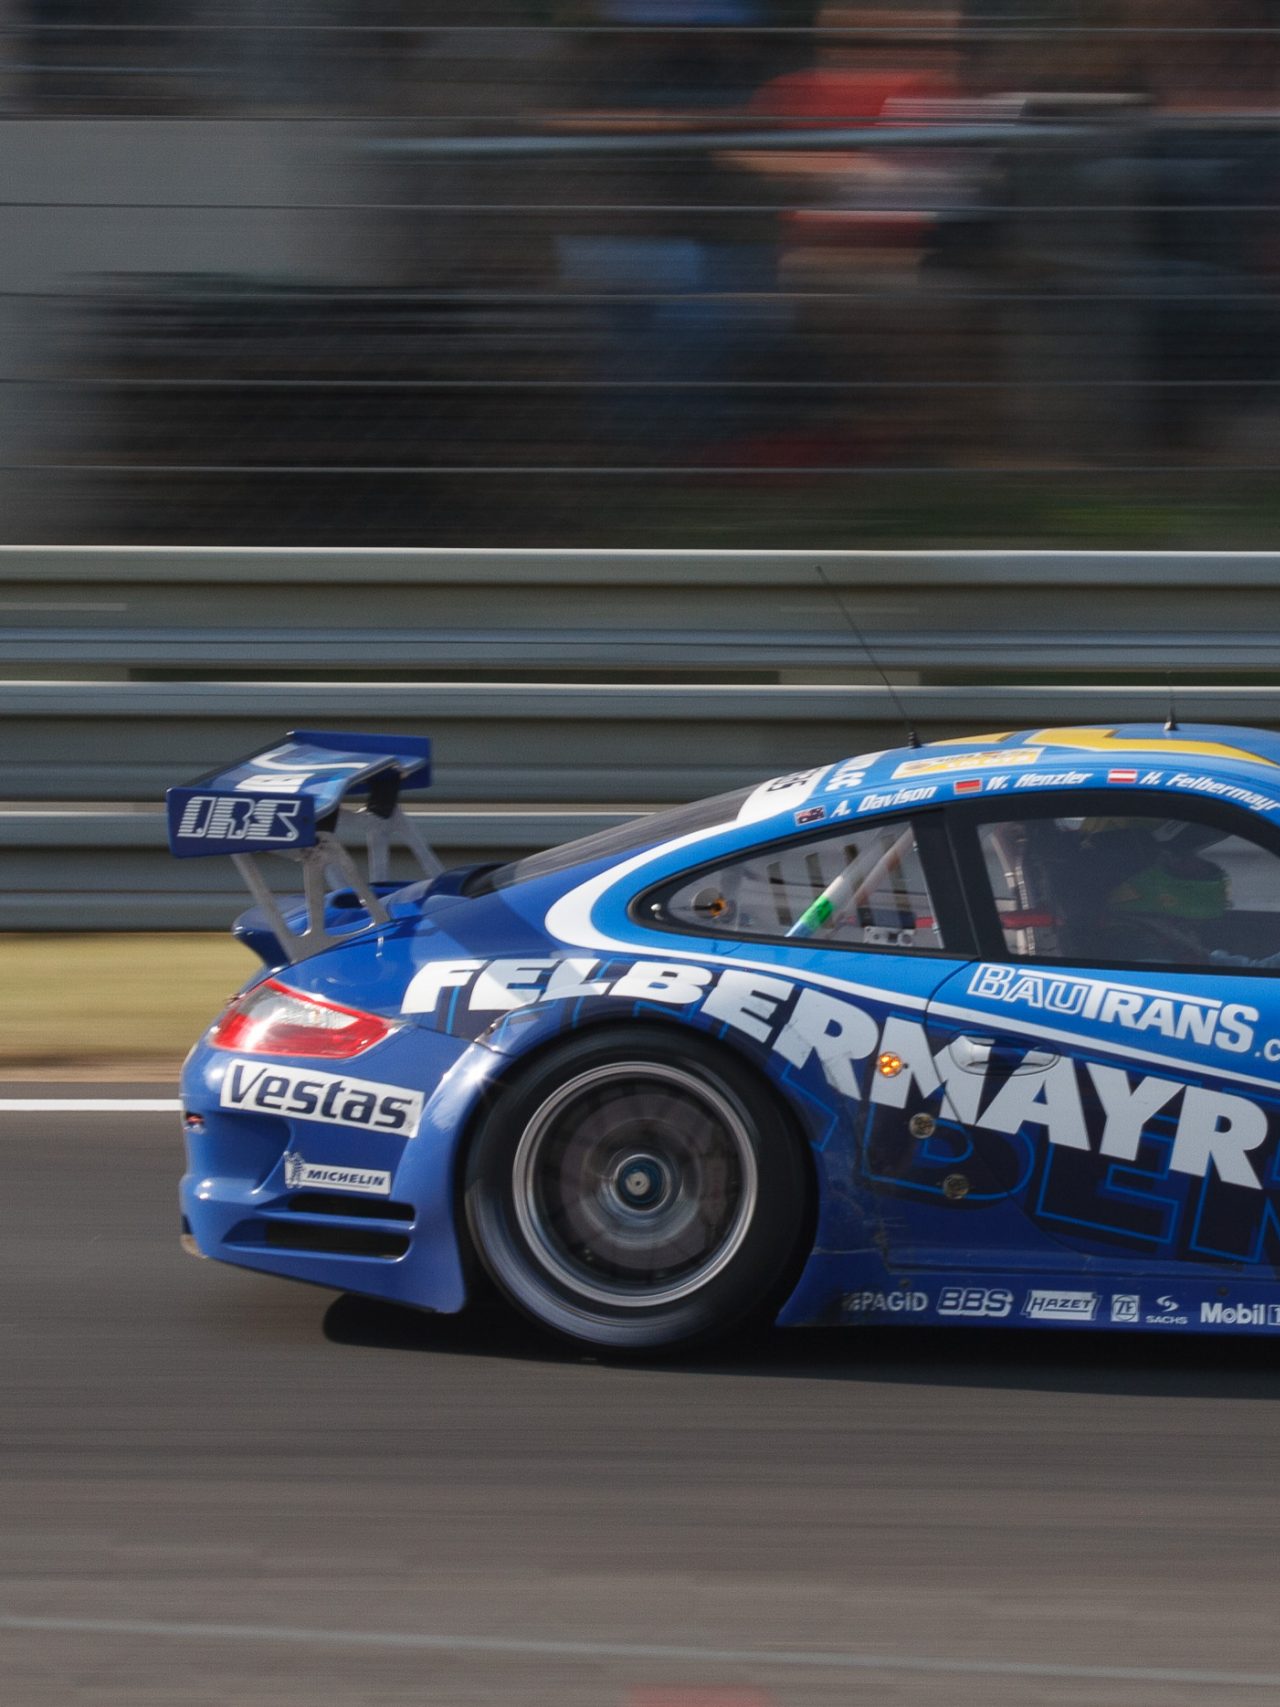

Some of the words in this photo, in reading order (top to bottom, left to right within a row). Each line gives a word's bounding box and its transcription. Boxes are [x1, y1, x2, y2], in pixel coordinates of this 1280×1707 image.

[1014, 771, 1094, 788] Henzler
[858, 785, 938, 813] Davison
[400, 957, 1268, 1190] FELBERMAYR
[230, 1064, 413, 1128] Vestas
[307, 1169, 385, 1186] MICHELIN
[937, 1287, 1014, 1317] BBS
[1030, 1296, 1092, 1312] HAZET
[1200, 1302, 1266, 1325] Mobil
[1146, 1315, 1188, 1325] SACHS
